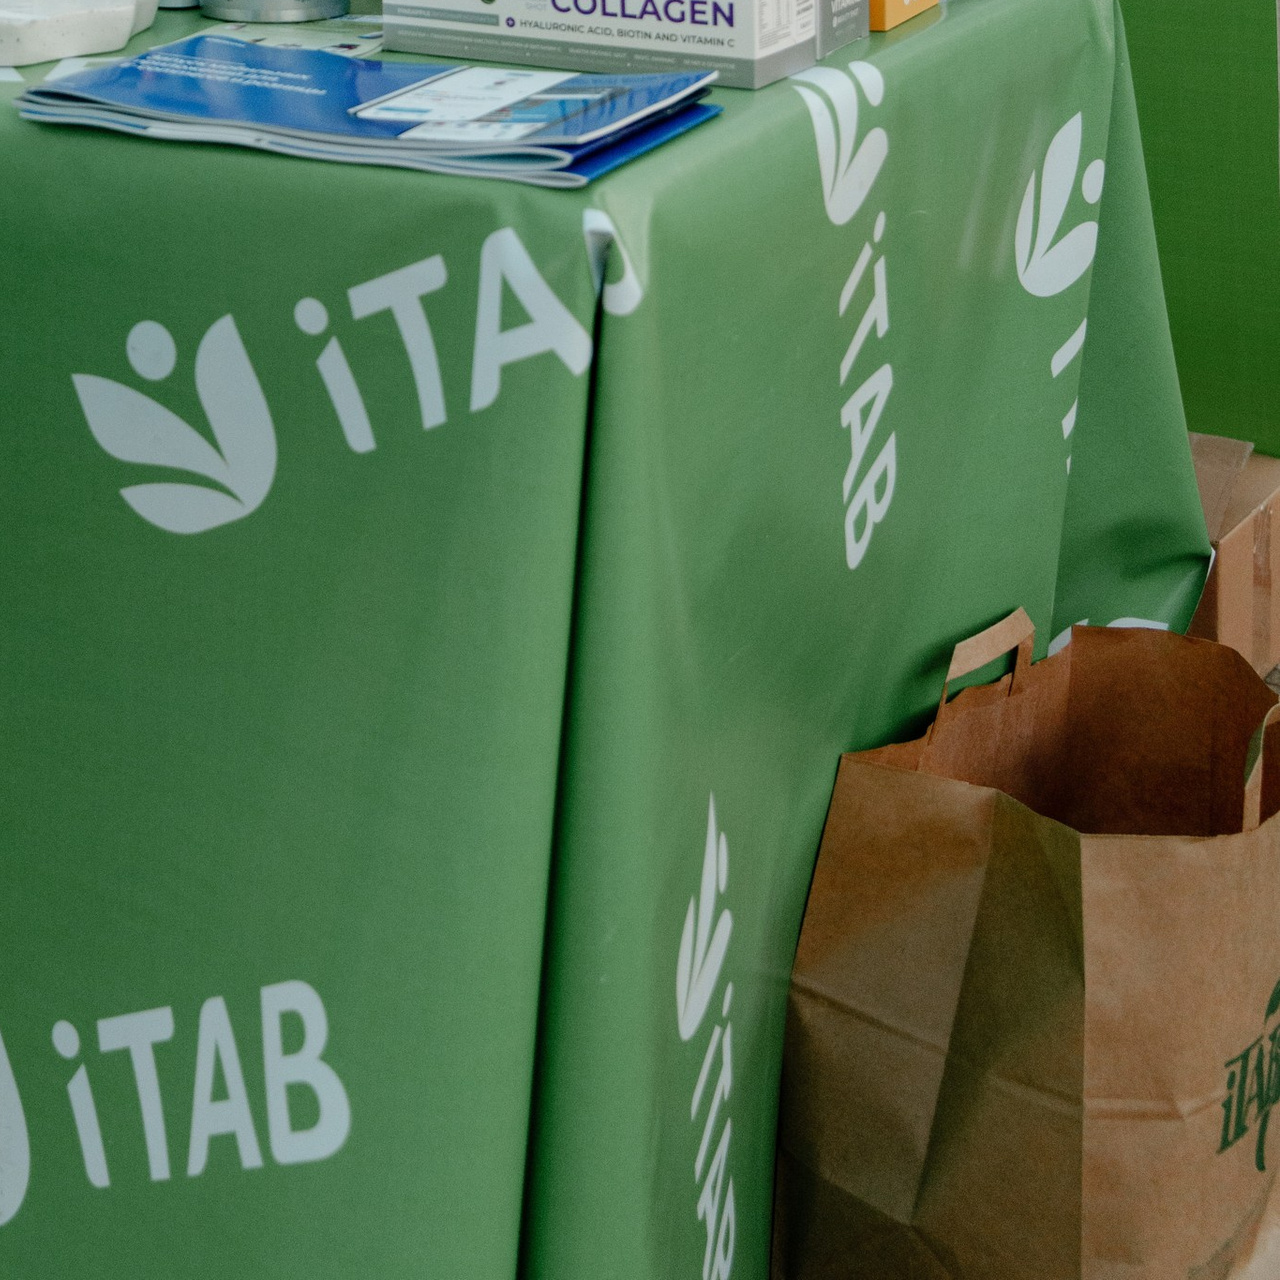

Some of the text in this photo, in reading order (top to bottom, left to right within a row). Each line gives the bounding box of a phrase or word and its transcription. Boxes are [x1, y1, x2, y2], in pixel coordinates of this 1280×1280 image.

[520, 20, 735, 48] HYALURONIC ACID, BIOTIN AND VITAMIN C
[51, 978, 352, 1189] iTAB
